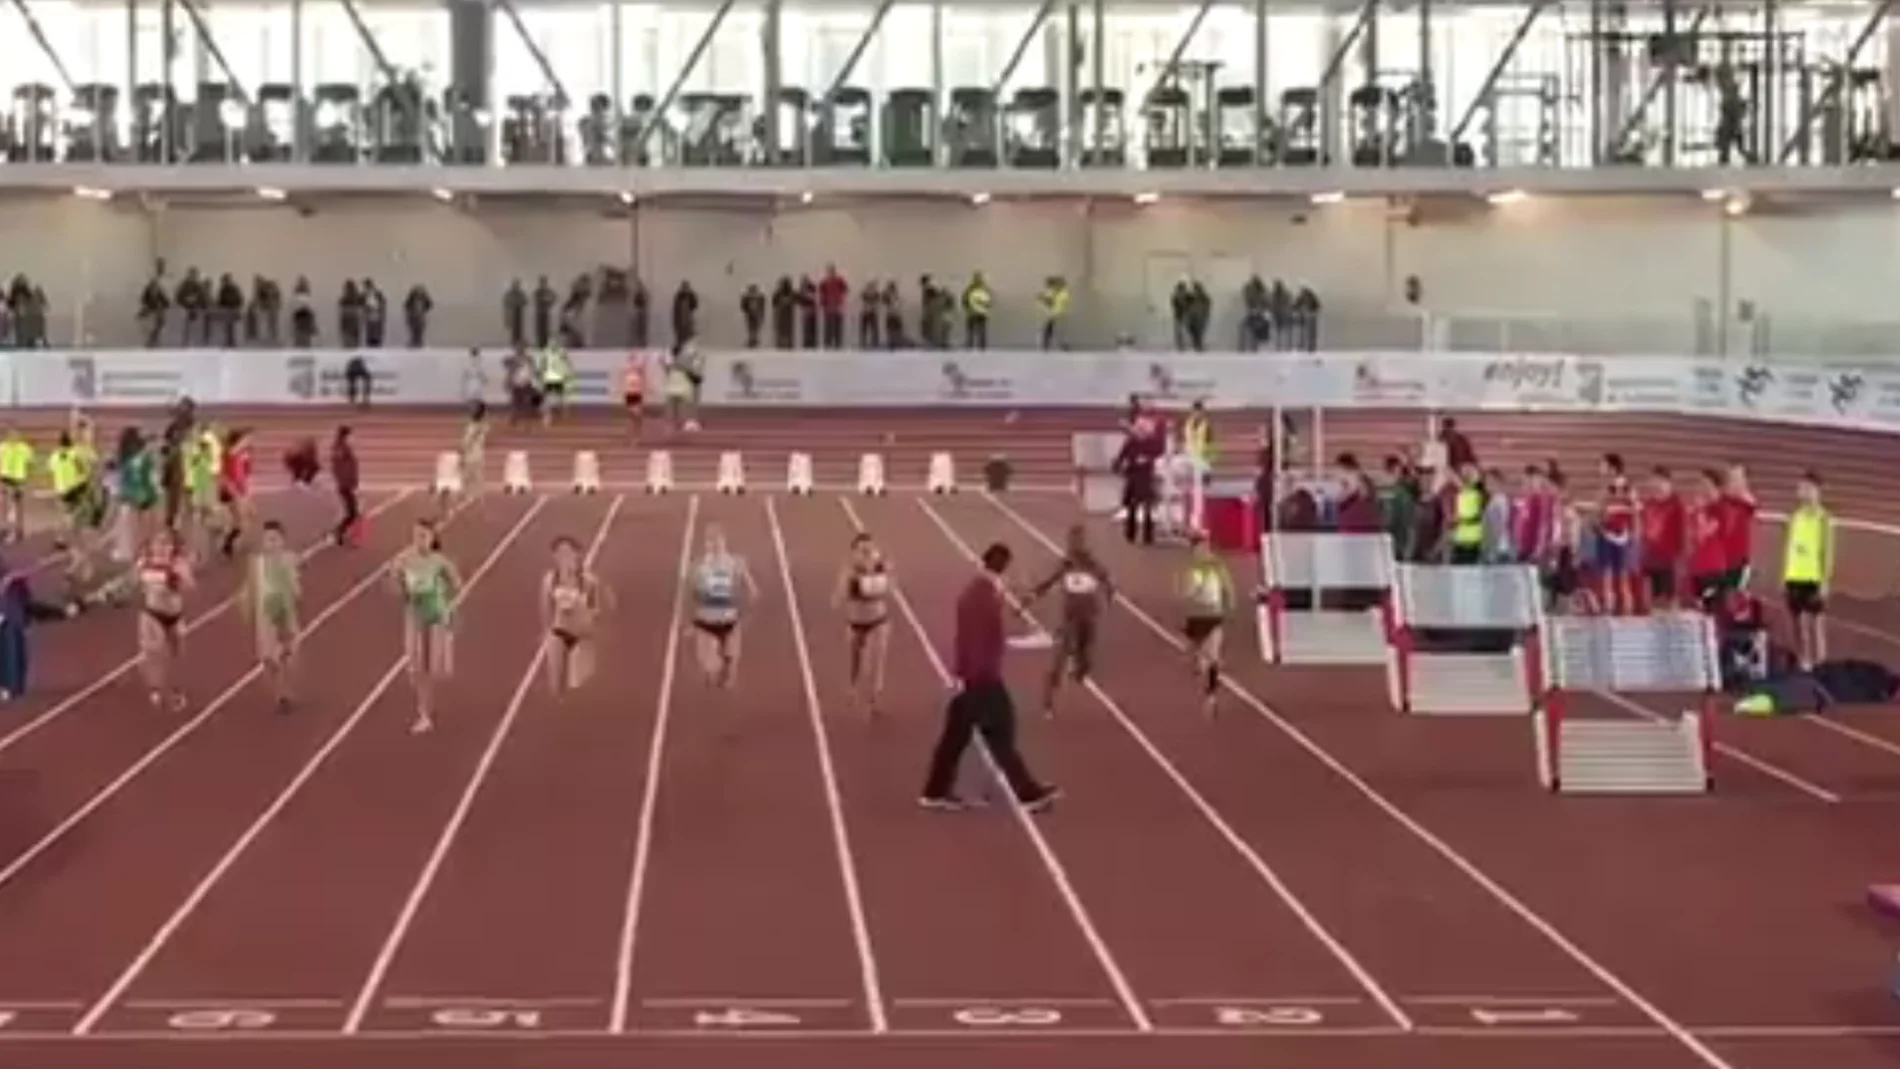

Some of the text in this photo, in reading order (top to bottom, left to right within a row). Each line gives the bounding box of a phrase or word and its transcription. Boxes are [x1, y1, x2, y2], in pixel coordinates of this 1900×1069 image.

[167, 1009, 276, 1027] 6
[432, 1009, 540, 1027] 5
[694, 1008, 801, 1027] 4
[953, 1008, 1062, 1024] 3
[1218, 1006, 1323, 1024] 2
[1471, 1007, 1578, 1024] 1
